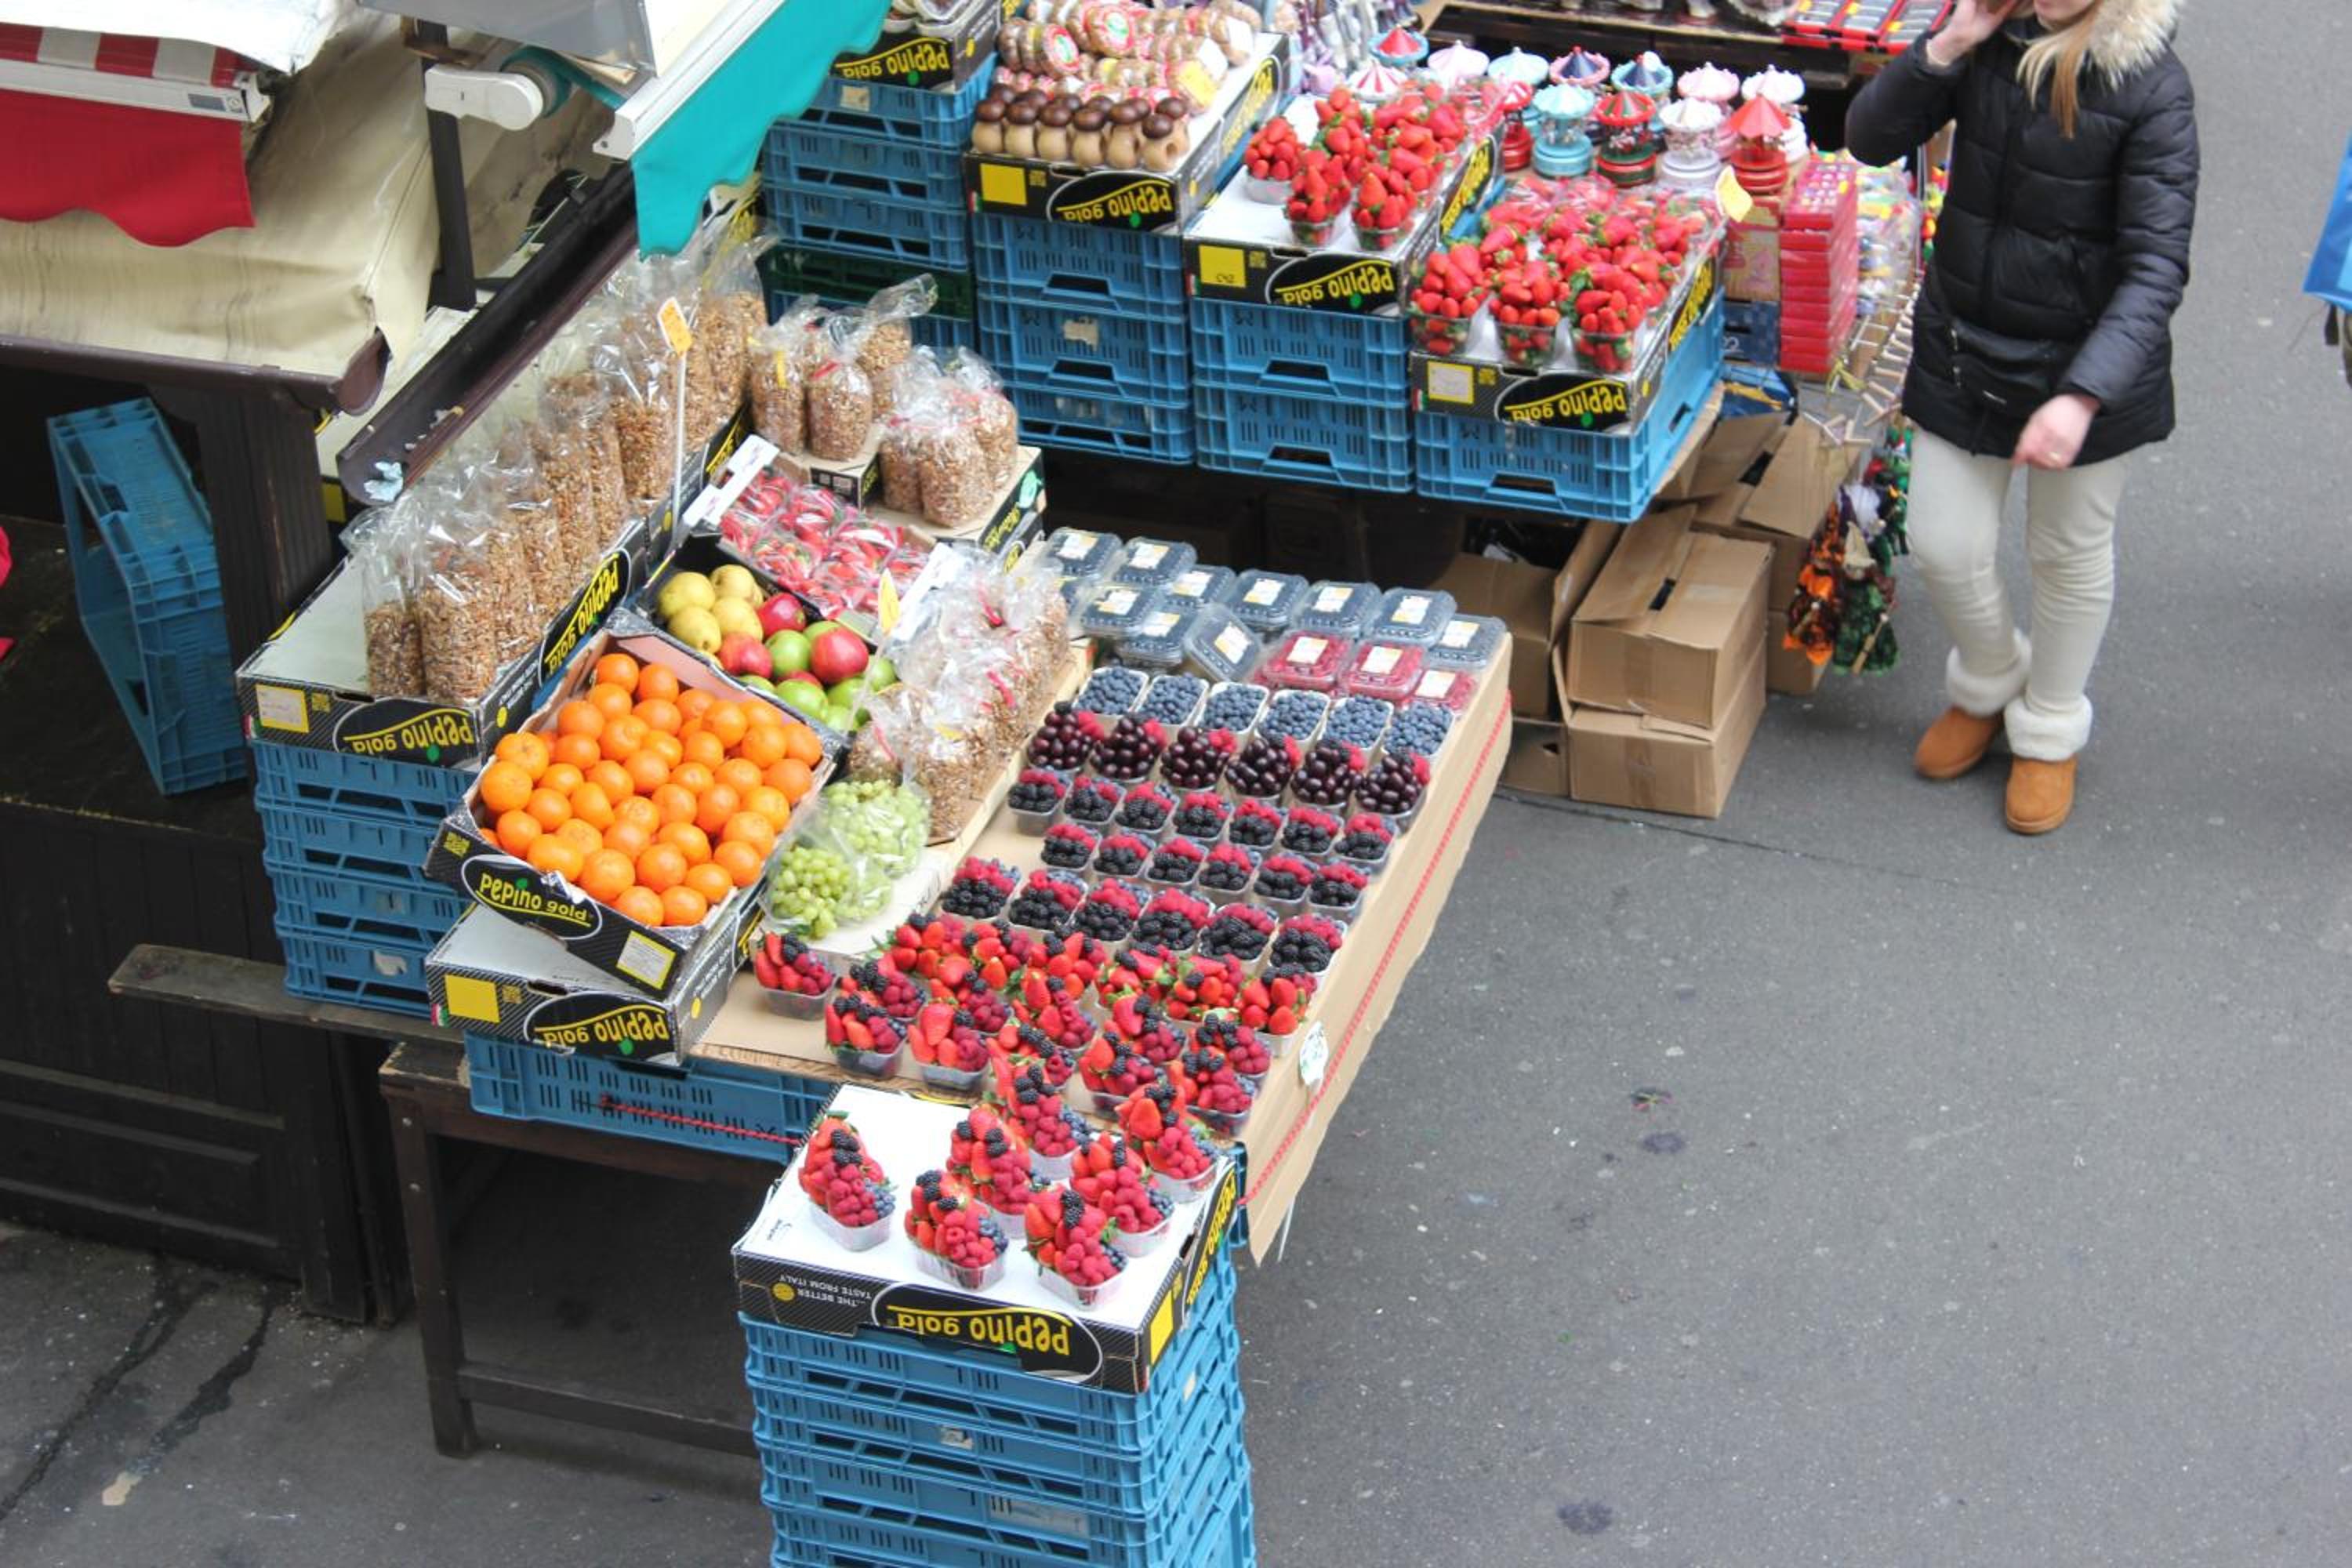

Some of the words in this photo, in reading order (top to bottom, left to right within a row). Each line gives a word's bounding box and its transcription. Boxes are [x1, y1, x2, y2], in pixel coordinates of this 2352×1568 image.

[480, 873, 542, 909] pepino
[546, 902, 587, 921] gold
[779, 1274, 807, 1286] ITALY
[809, 1280, 839, 1293] FROM
[798, 1289, 835, 1302] BETTER
[841, 1287, 872, 1299] TASTE
[969, 1315, 1070, 1356] pepino
